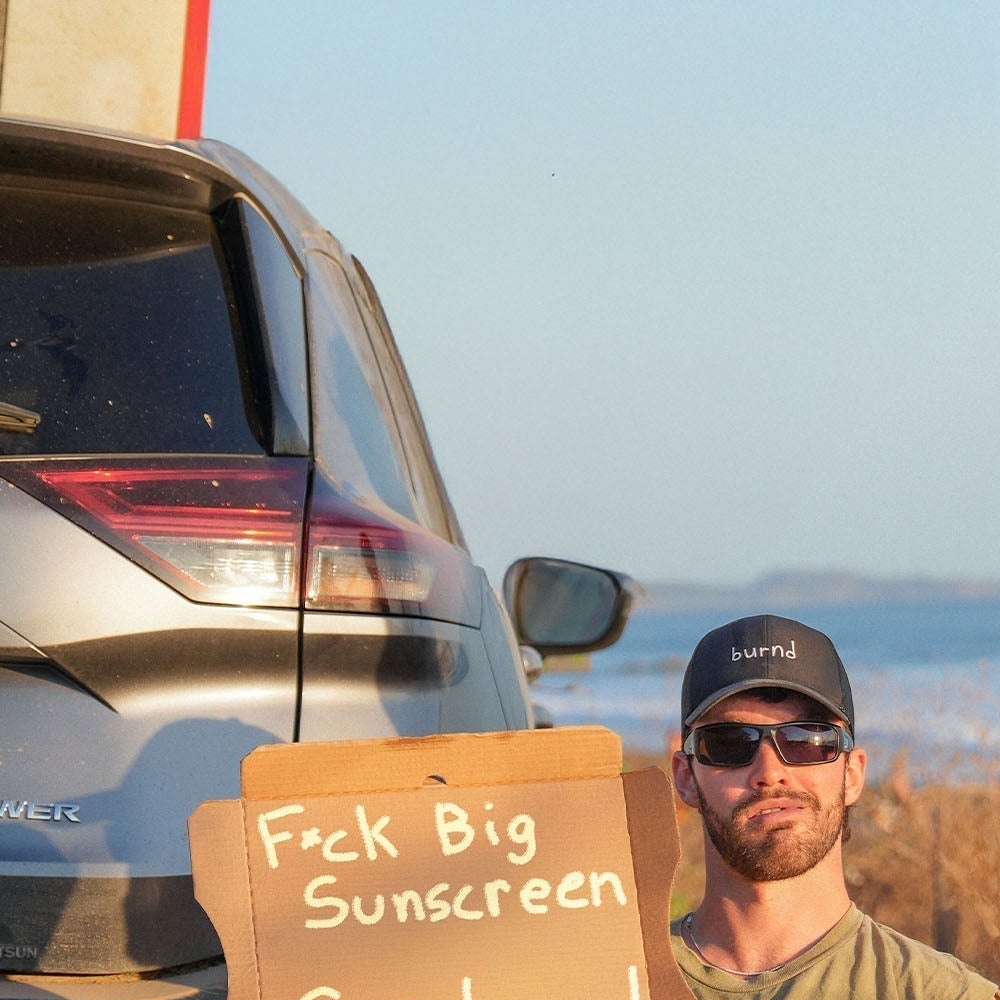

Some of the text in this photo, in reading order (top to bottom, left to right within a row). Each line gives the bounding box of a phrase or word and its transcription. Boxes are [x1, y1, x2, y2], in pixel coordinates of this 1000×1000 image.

[731, 640, 797, 662] burnd
[434, 801, 538, 866] Big
[303, 870, 629, 930] Sunscreen
